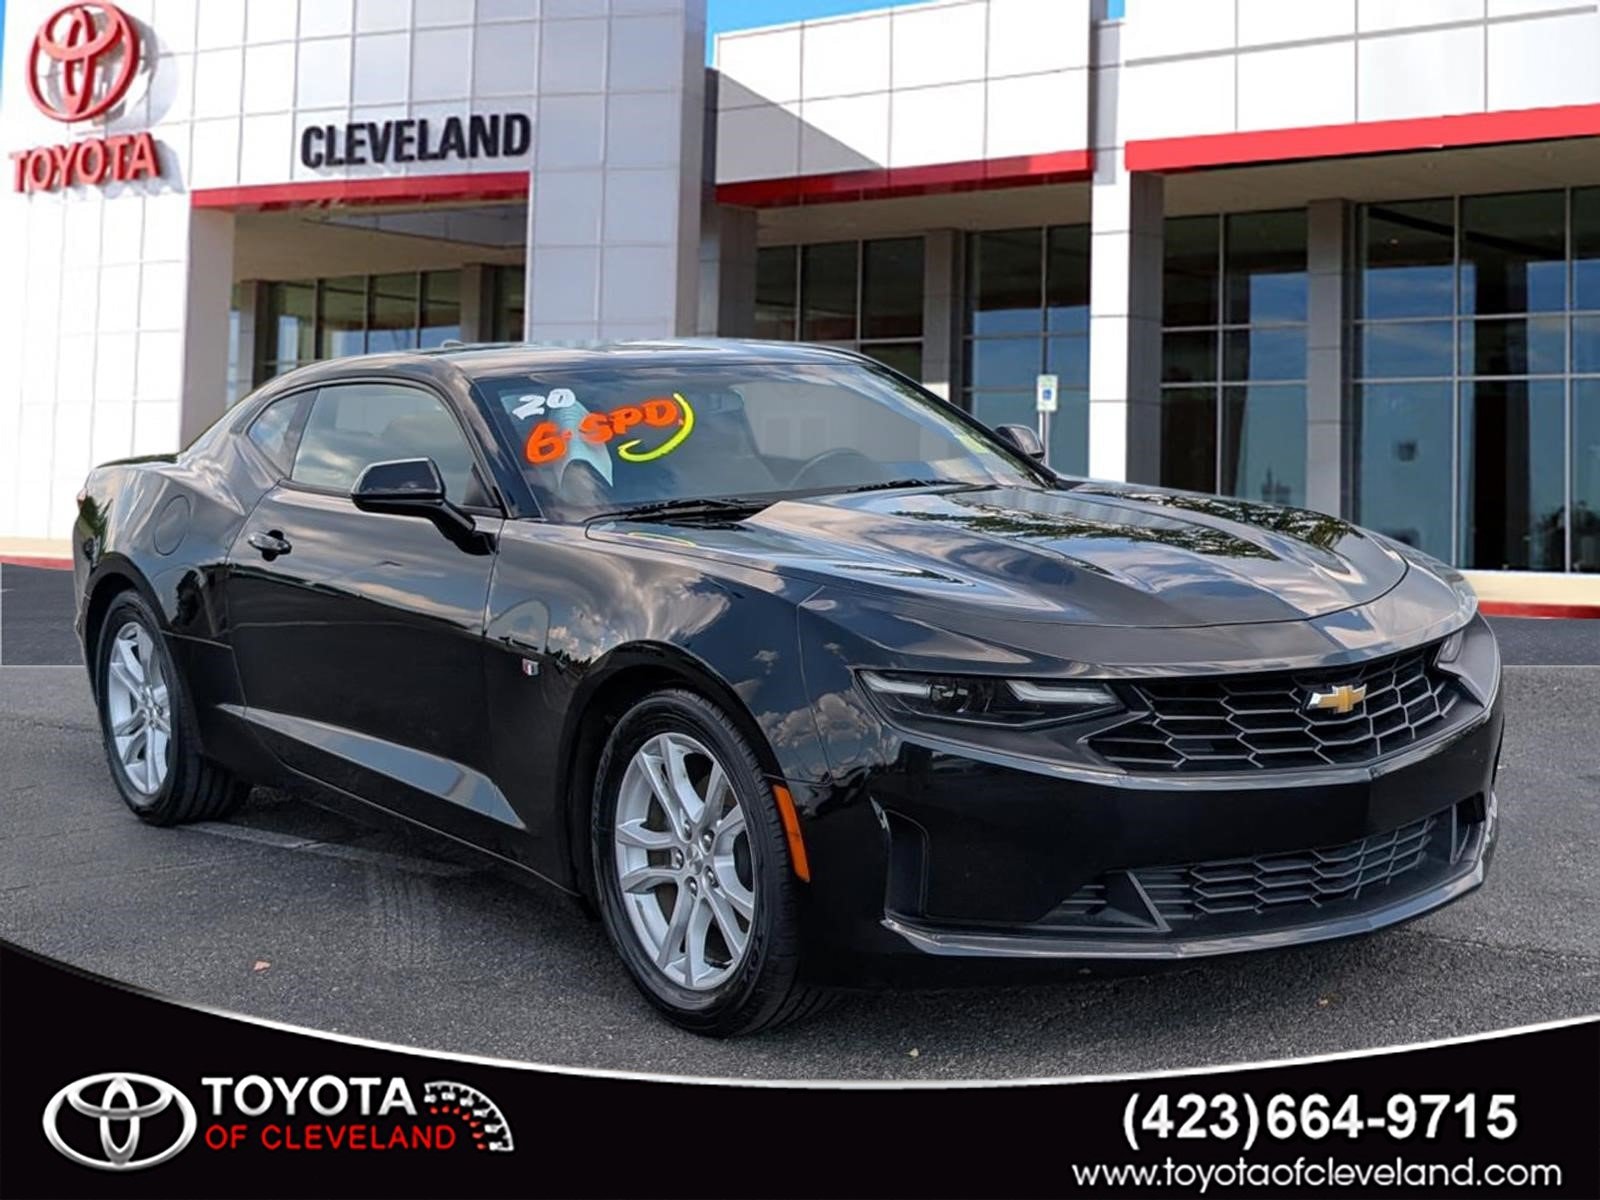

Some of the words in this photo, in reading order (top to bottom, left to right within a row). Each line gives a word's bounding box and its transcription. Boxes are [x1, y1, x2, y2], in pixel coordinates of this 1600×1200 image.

[9, 132, 162, 193] TOYOTA
[302, 113, 531, 168] CLEVELAND
[512, 388, 576, 420] 20
